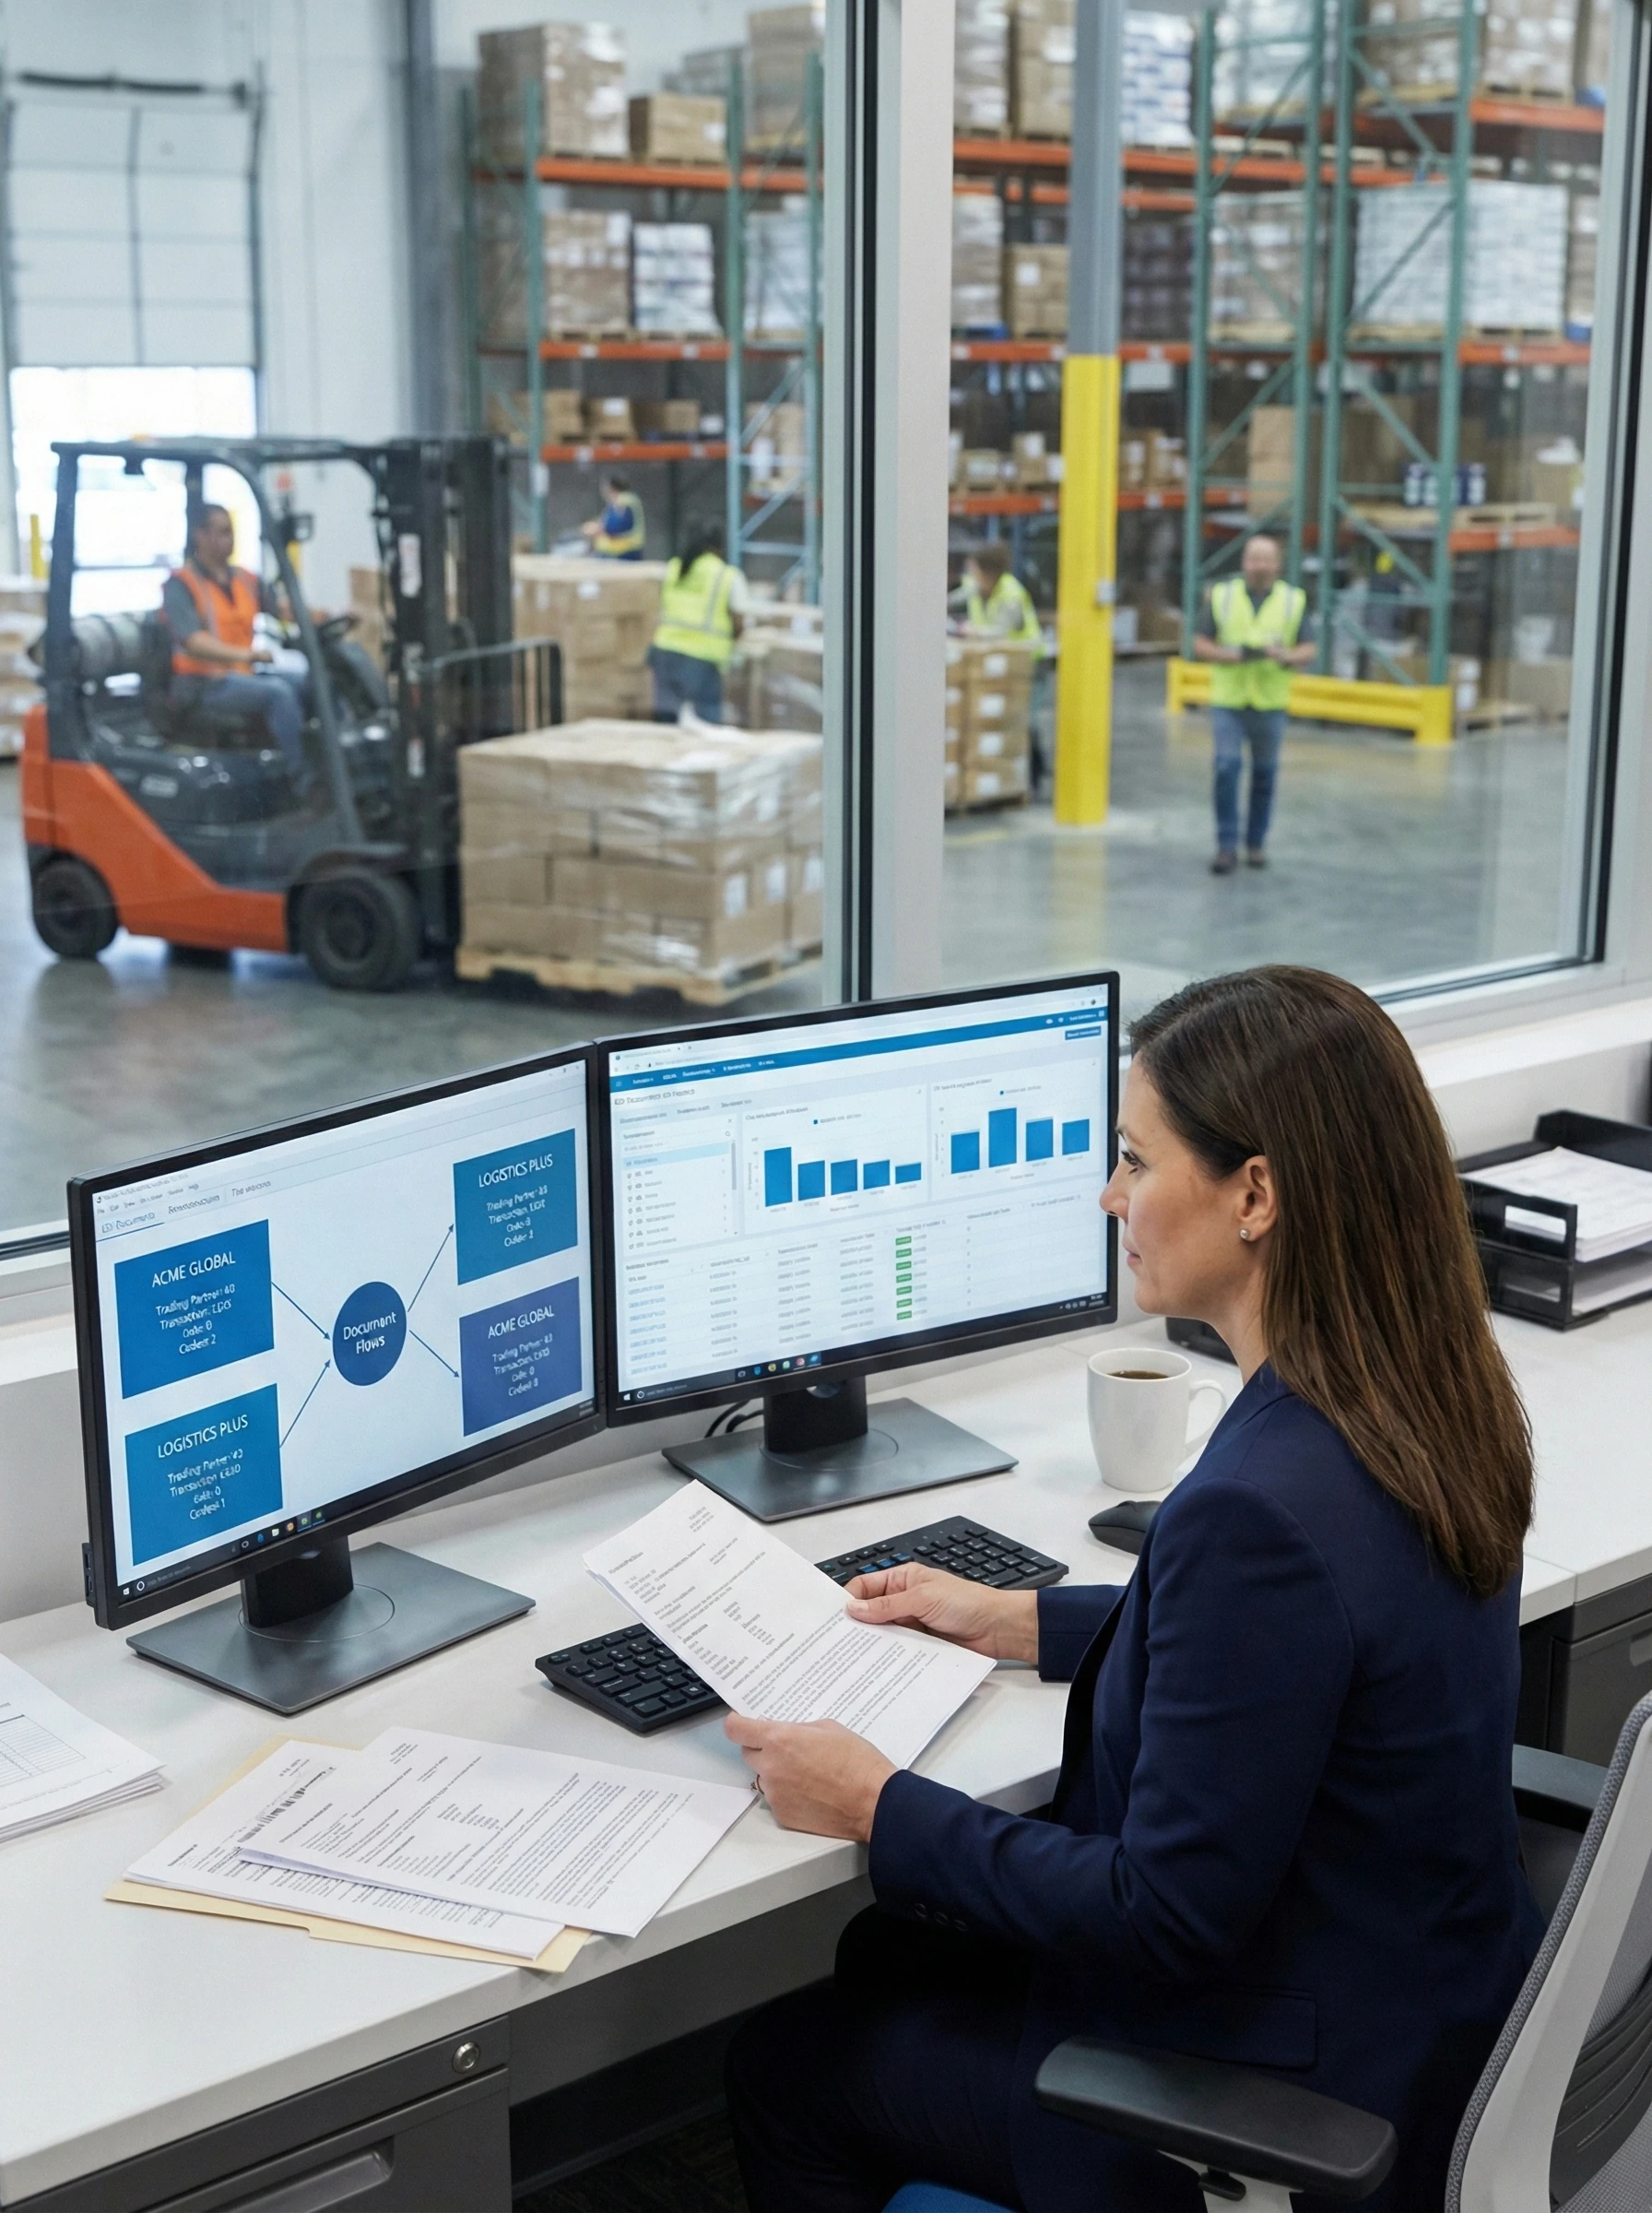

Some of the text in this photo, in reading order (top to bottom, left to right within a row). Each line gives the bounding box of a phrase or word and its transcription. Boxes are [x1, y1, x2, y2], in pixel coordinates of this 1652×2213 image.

[479, 1154, 553, 1188] LOGISTICS PLUS
[152, 1251, 236, 1287] ACME GLOBAL
[488, 1305, 554, 1339] ACME GLOBAL
[356, 1335, 385, 1355] Flows
[158, 1414, 248, 1458] LOGISTICS PLUS
